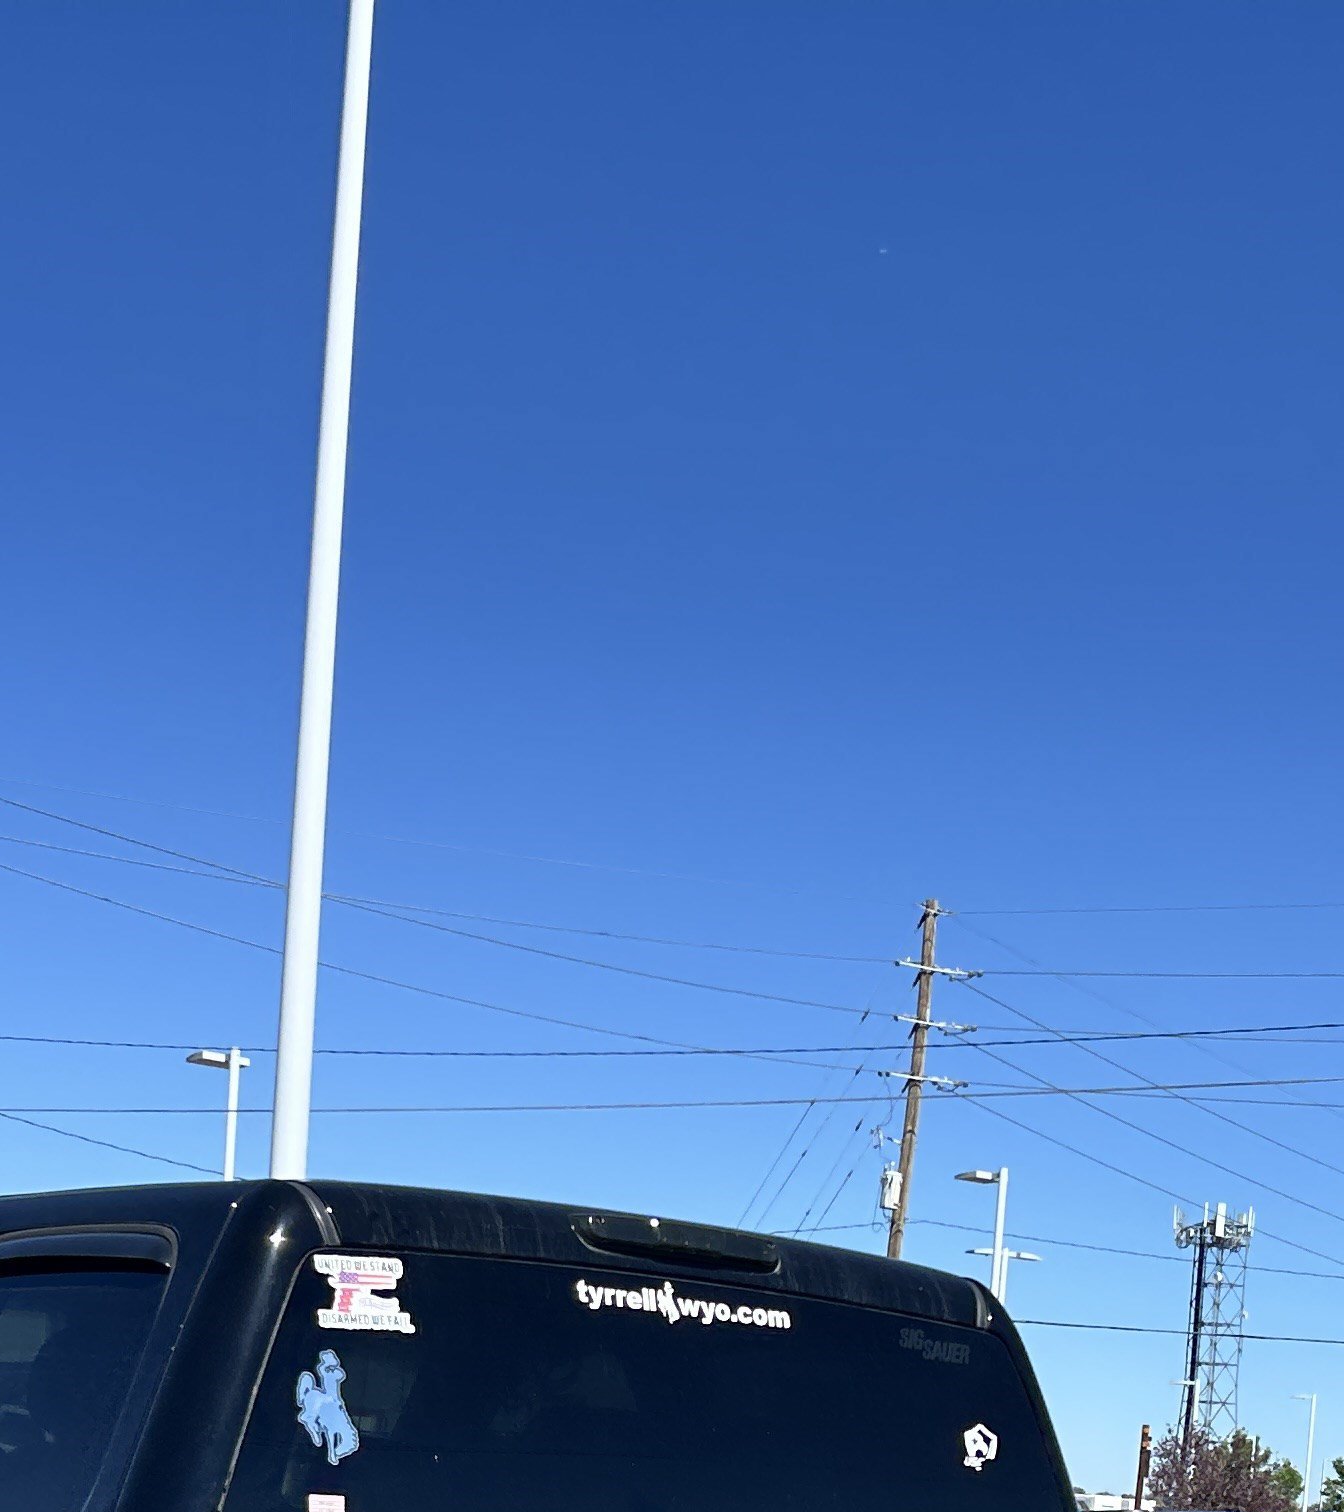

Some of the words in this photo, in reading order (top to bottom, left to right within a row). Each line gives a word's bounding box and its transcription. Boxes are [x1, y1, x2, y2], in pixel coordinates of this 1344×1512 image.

[317, 1259, 352, 1272] UNITED
[354, 1260, 369, 1271] WE
[370, 1261, 400, 1274] STAND
[575, 1279, 657, 1312] tyrrell
[677, 1296, 792, 1329] wyo.com
[321, 1313, 370, 1325] DISARMED
[371, 1315, 385, 1325] WE
[899, 1327, 925, 1350] SIG
[922, 1339, 970, 1365] SAUER
